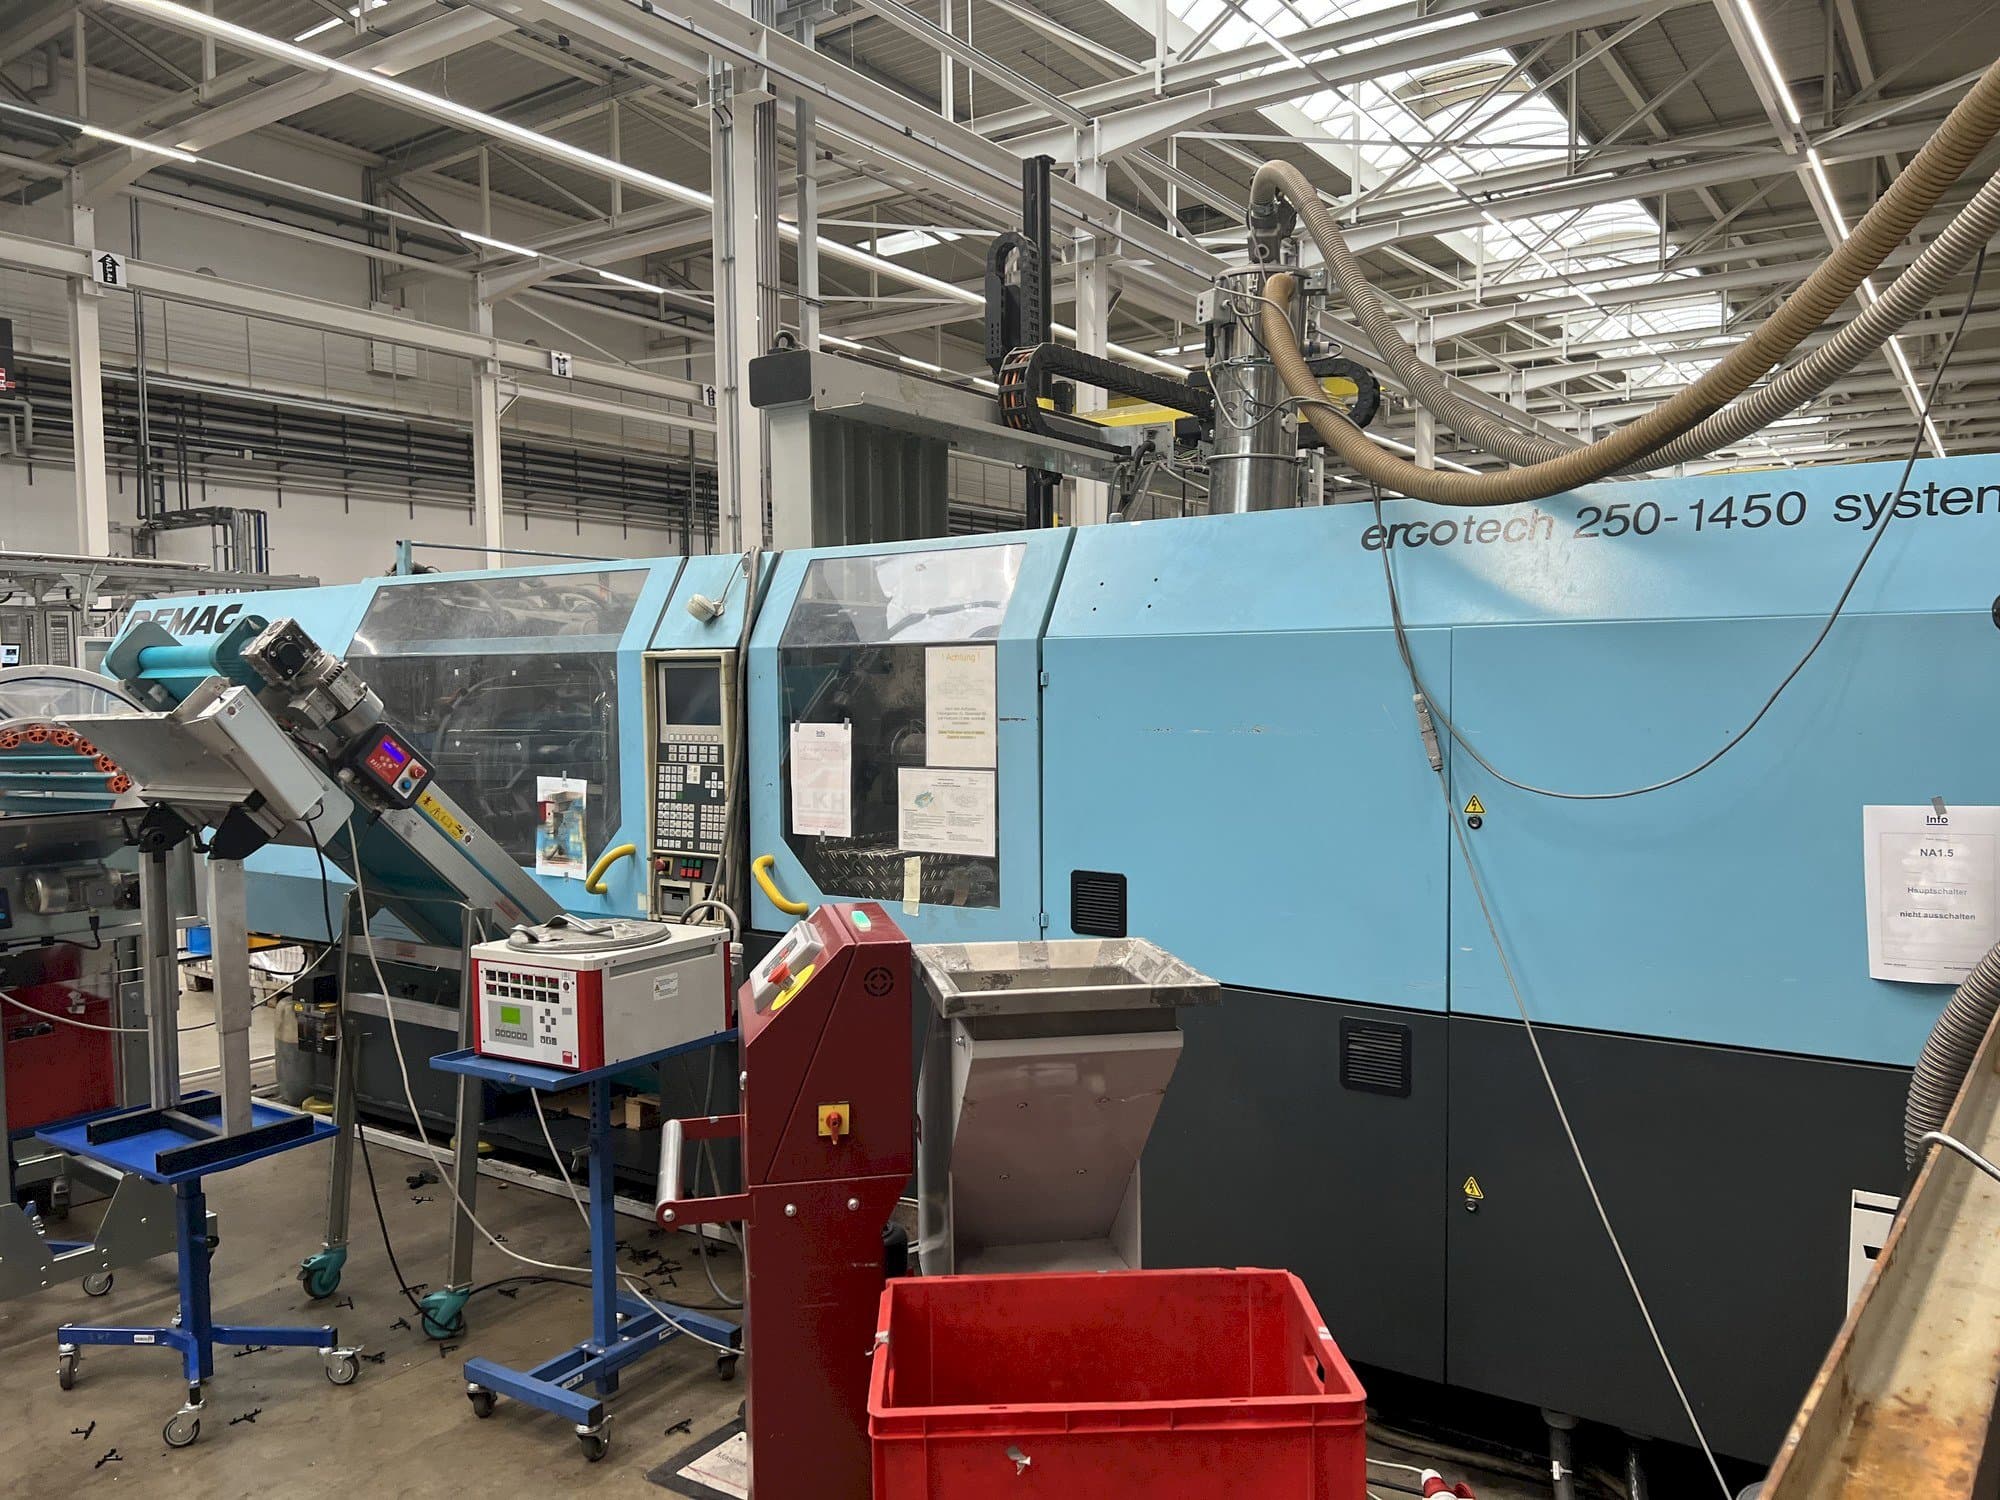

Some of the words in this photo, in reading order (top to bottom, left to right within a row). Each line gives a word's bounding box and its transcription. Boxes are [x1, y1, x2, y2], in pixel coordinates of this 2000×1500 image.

[1573, 490, 1807, 539] 250-1450
[1926, 814, 1949, 826] Info
[1920, 848, 1955, 858] NA1.5
[1907, 886, 1968, 897] Hauptschalter
[1899, 911, 1921, 920] nicht
[1922, 912, 1976, 921] ausschalten
